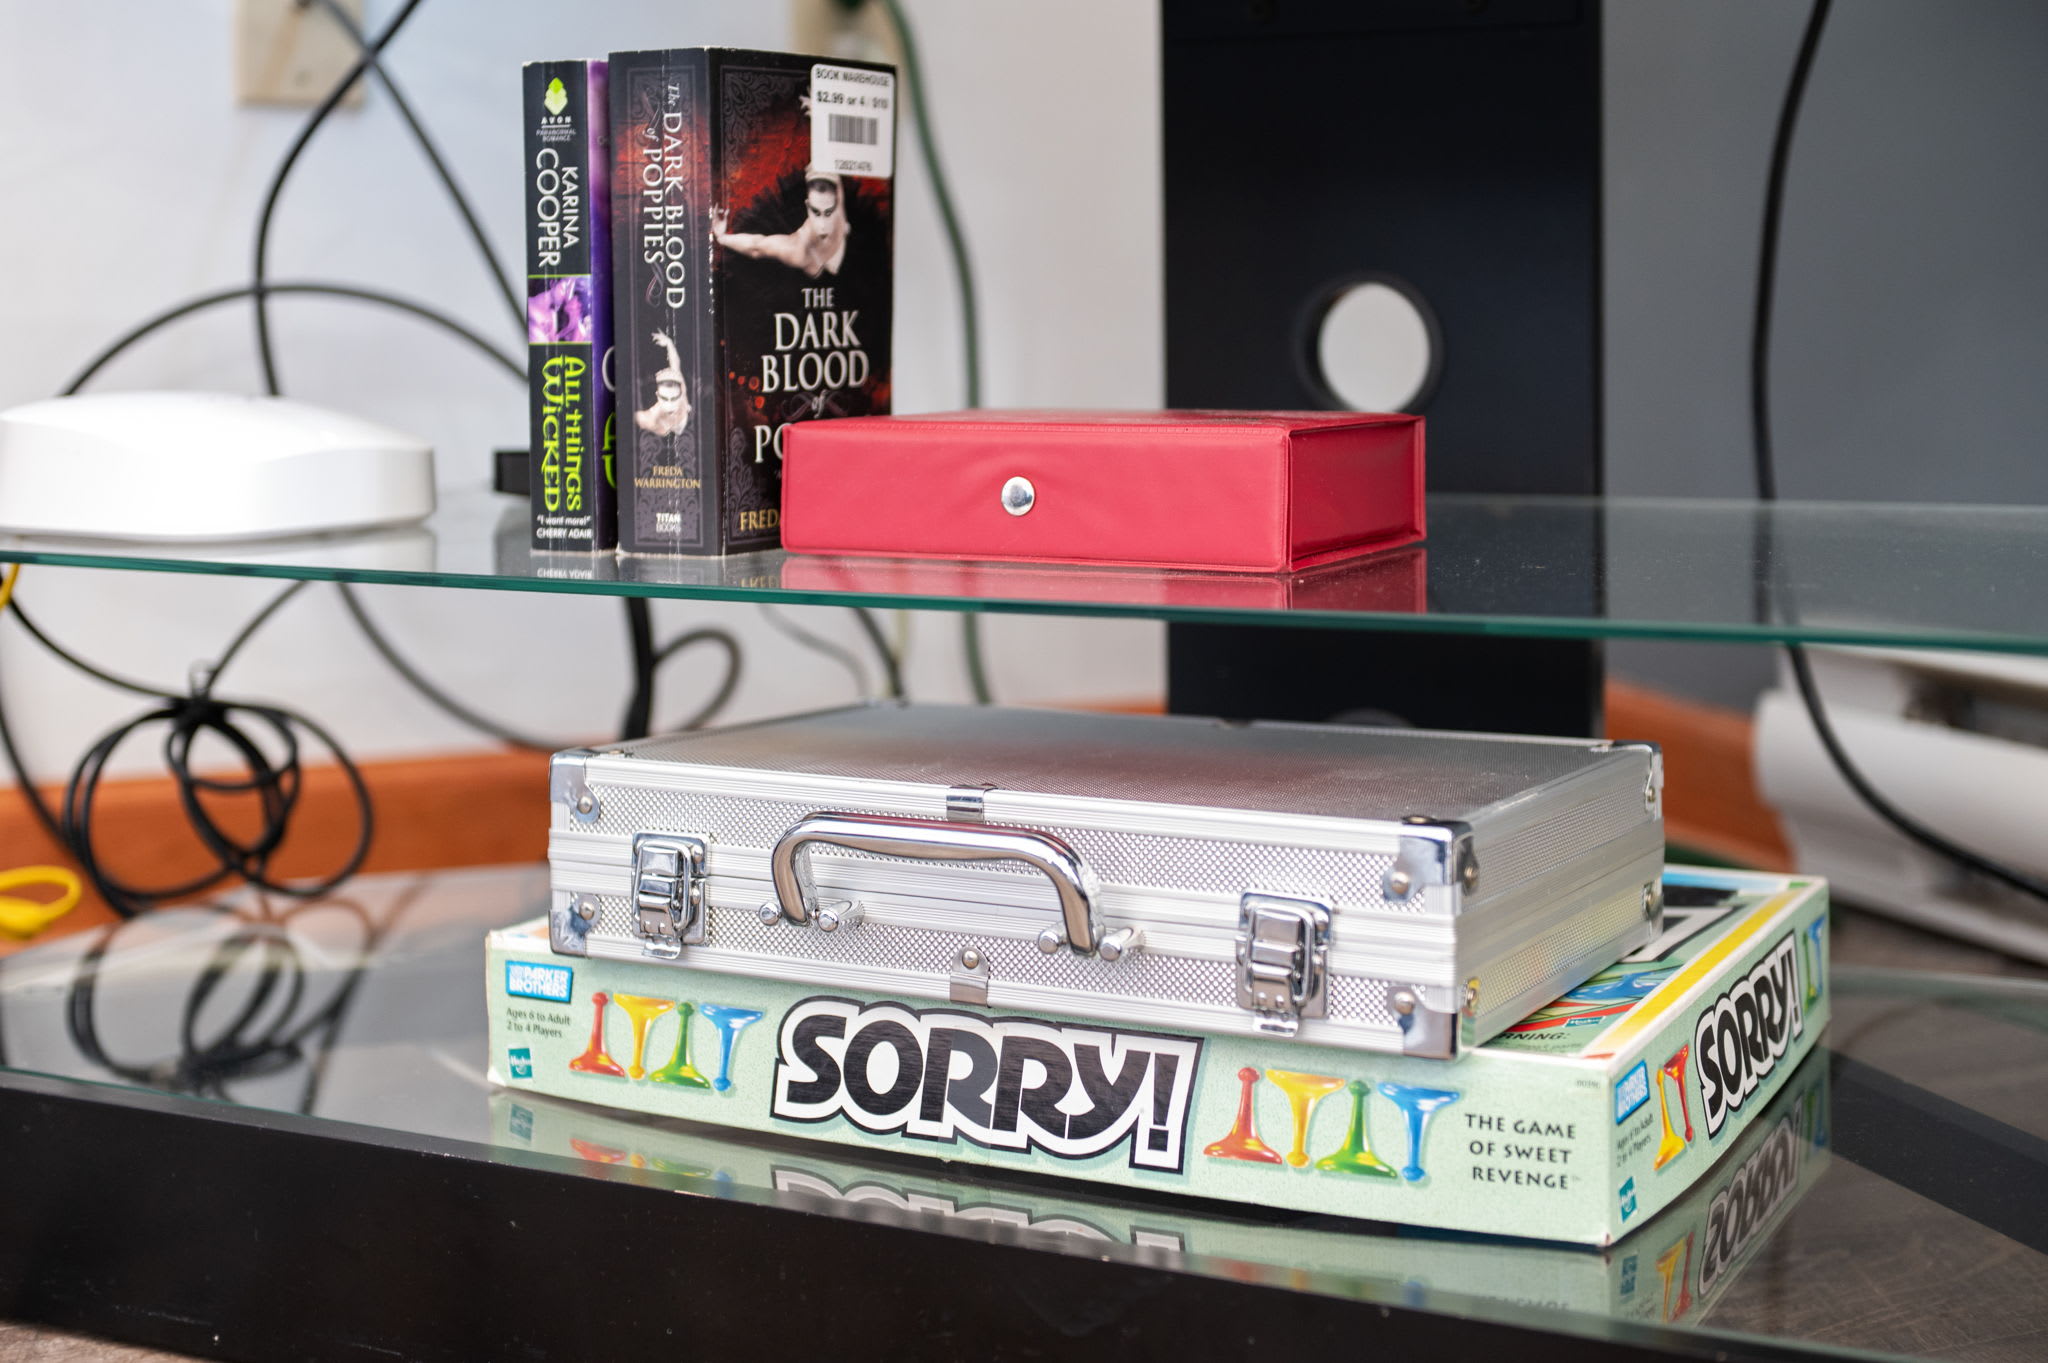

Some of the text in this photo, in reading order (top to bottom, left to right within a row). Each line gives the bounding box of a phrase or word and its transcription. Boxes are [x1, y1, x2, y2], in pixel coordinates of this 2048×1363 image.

[663, 111, 684, 195] DARK
[536, 148, 561, 268] COOPER
[562, 166, 580, 249] KARINA
[643, 148, 665, 266] POPPIES
[664, 205, 686, 309] BLOOD
[801, 287, 834, 308] THE
[774, 310, 862, 351] DARK
[761, 350, 870, 393] BLOOD
[652, 465, 684, 477] FREDA
[634, 477, 702, 489] WARRINGTON
[656, 512, 682, 523] TITAN
[739, 509, 780, 532] FRED
[536, 528, 593, 539] CHERRY ADAIR
[524, 965, 569, 982] PARKER
[509, 978, 568, 998] BROTHERS
[506, 1007, 526, 1019] Ages
[537, 1012, 546, 1021] to
[548, 1013, 571, 1026] Adult
[514, 1022, 523, 1032] to
[533, 1024, 562, 1038] Players
[1500, 1031, 1570, 1041] RNING:
[1696, 933, 1802, 1136] SORRY!
[772, 997, 1203, 1172] SORRY!
[1465, 1113, 1576, 1139] THE GAME
[1469, 1141, 1572, 1164] OF SWEET
[1472, 1167, 1568, 1190] REVENGE
